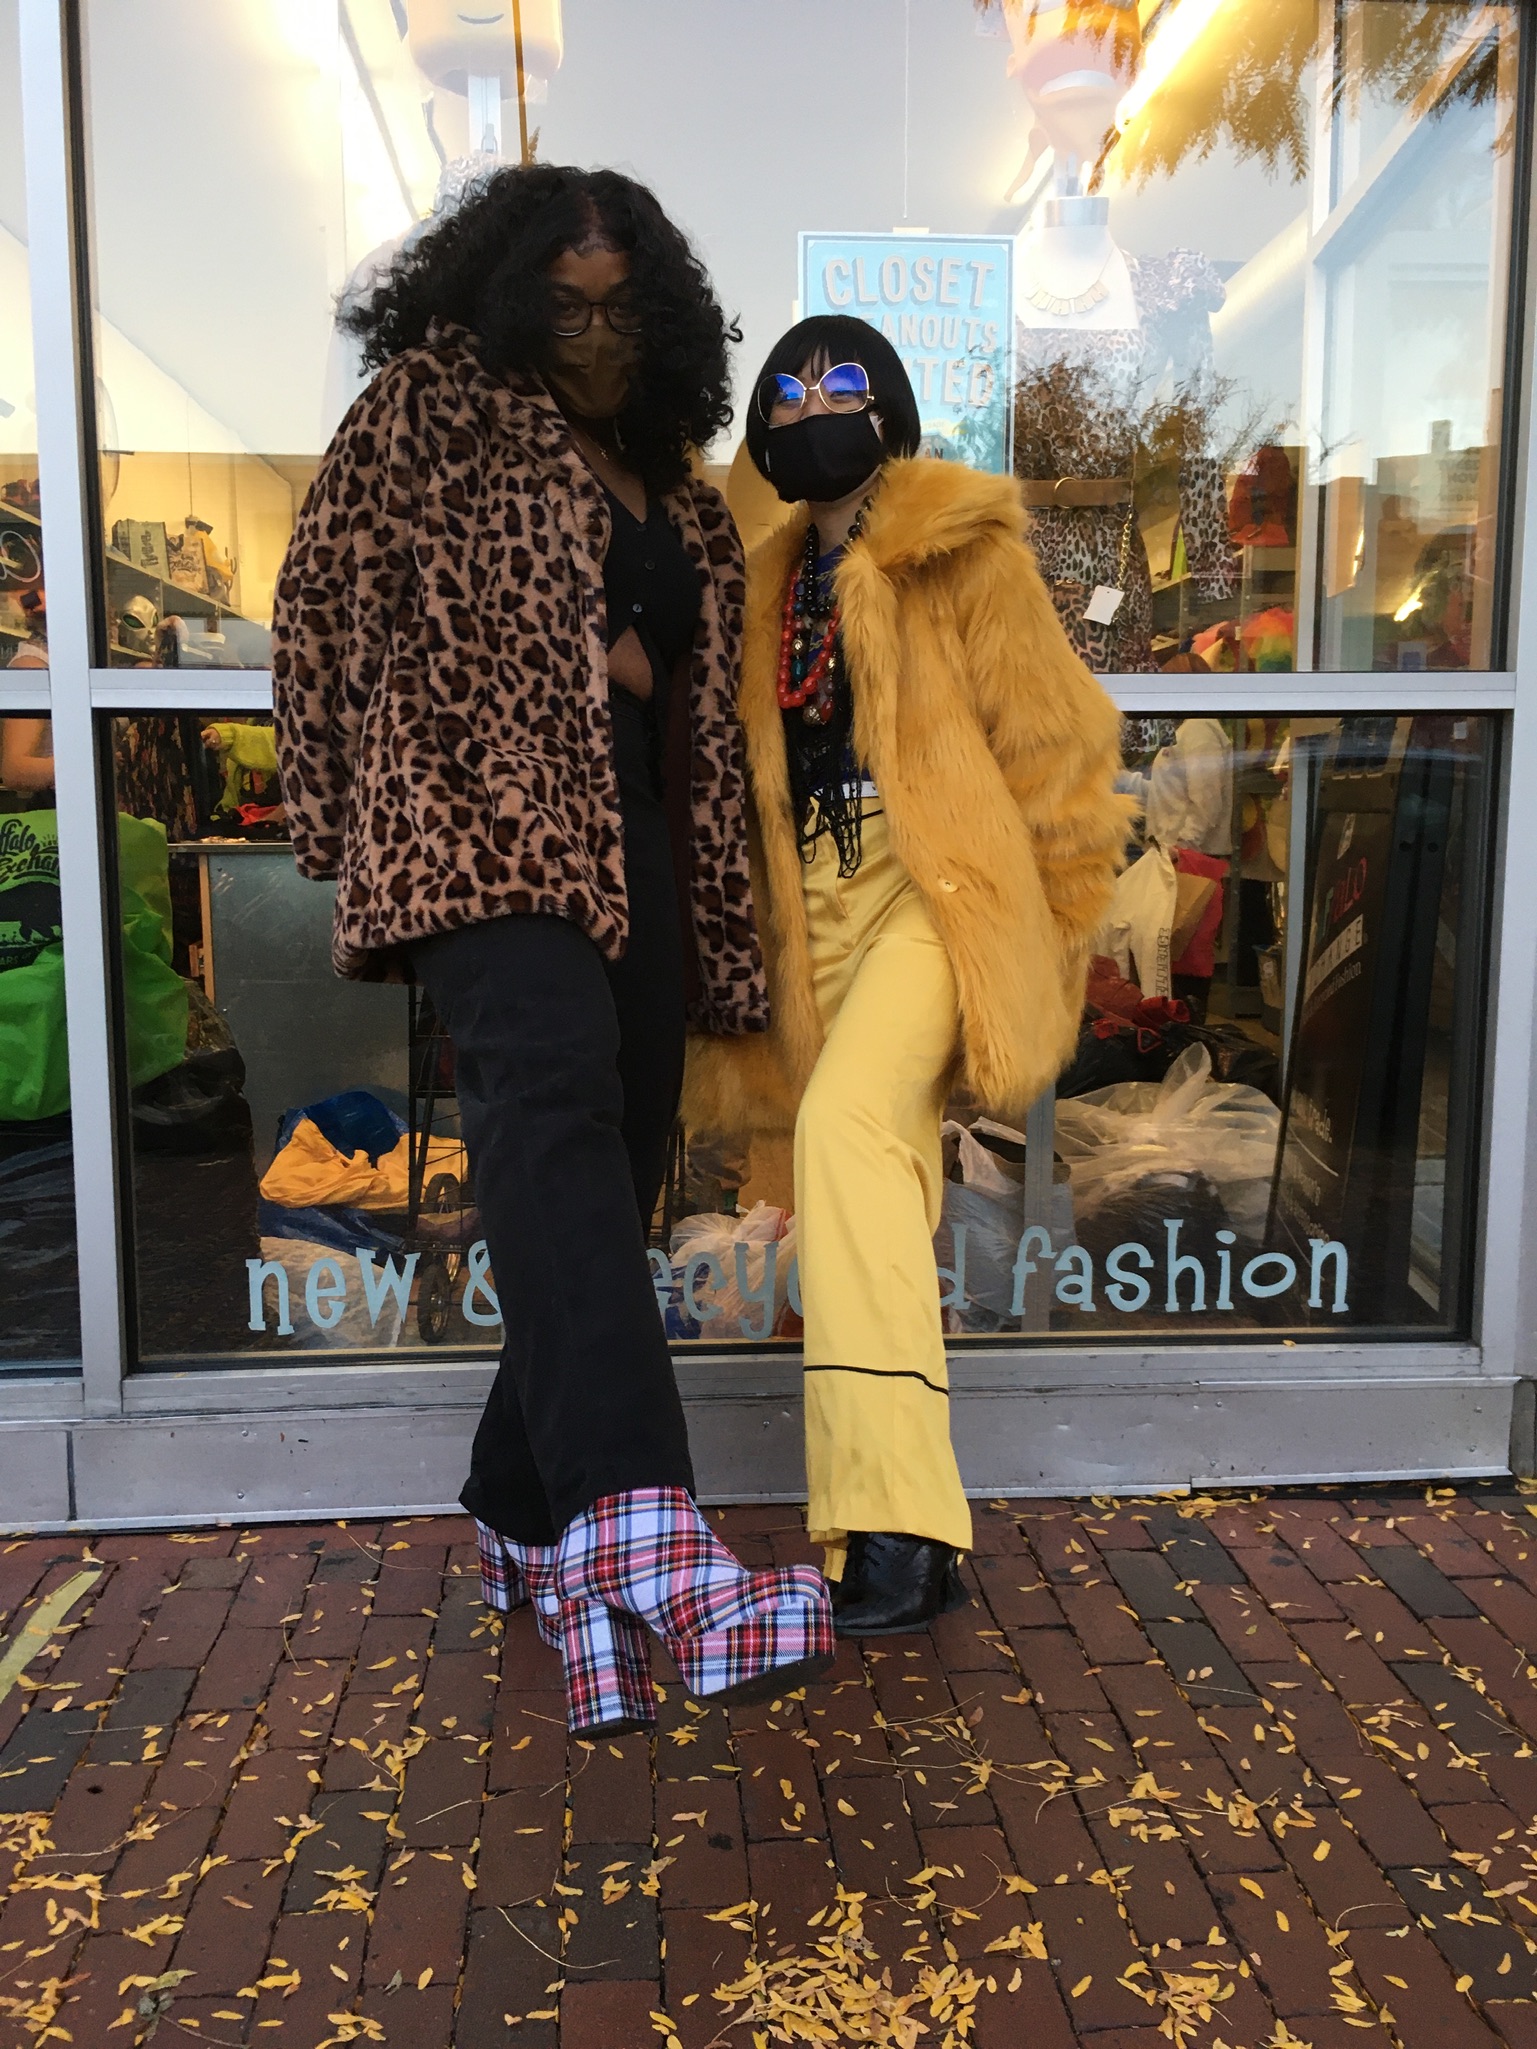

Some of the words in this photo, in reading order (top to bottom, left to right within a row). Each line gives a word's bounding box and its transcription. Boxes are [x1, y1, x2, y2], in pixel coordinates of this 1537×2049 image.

[824, 256, 995, 309] CLOSET
[859, 313, 1000, 353] ANOUTS
[905, 357, 996, 407] TED
[0, 818, 36, 856] ffalo
[245, 1246, 421, 1336] new
[462, 1239, 504, 1327] &
[643, 1222, 972, 1342] ecyd
[1009, 1218, 1349, 1317] fashion
